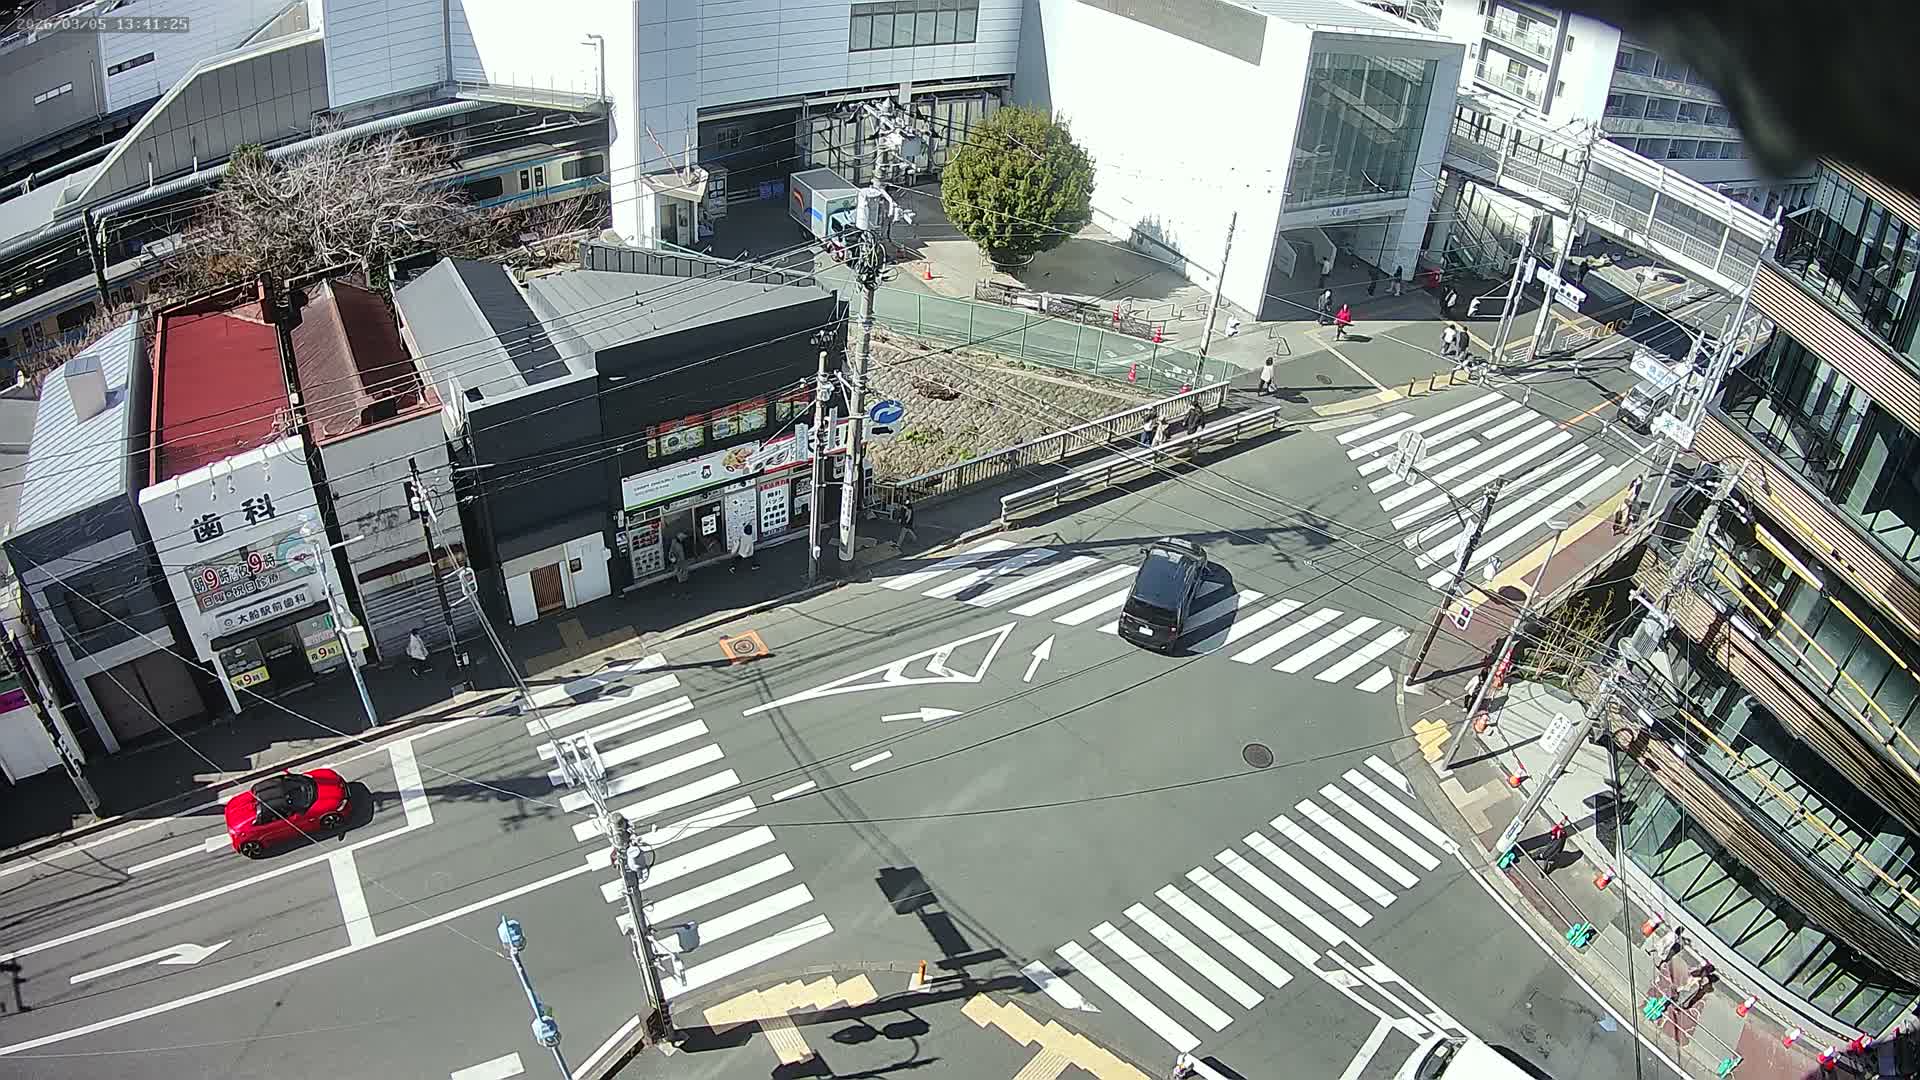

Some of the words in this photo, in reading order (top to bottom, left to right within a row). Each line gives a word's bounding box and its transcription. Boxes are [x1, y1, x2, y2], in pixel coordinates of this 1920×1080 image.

[191, 493, 276, 543] 歯科
[238, 593, 306, 625] 大船駅前歯科
